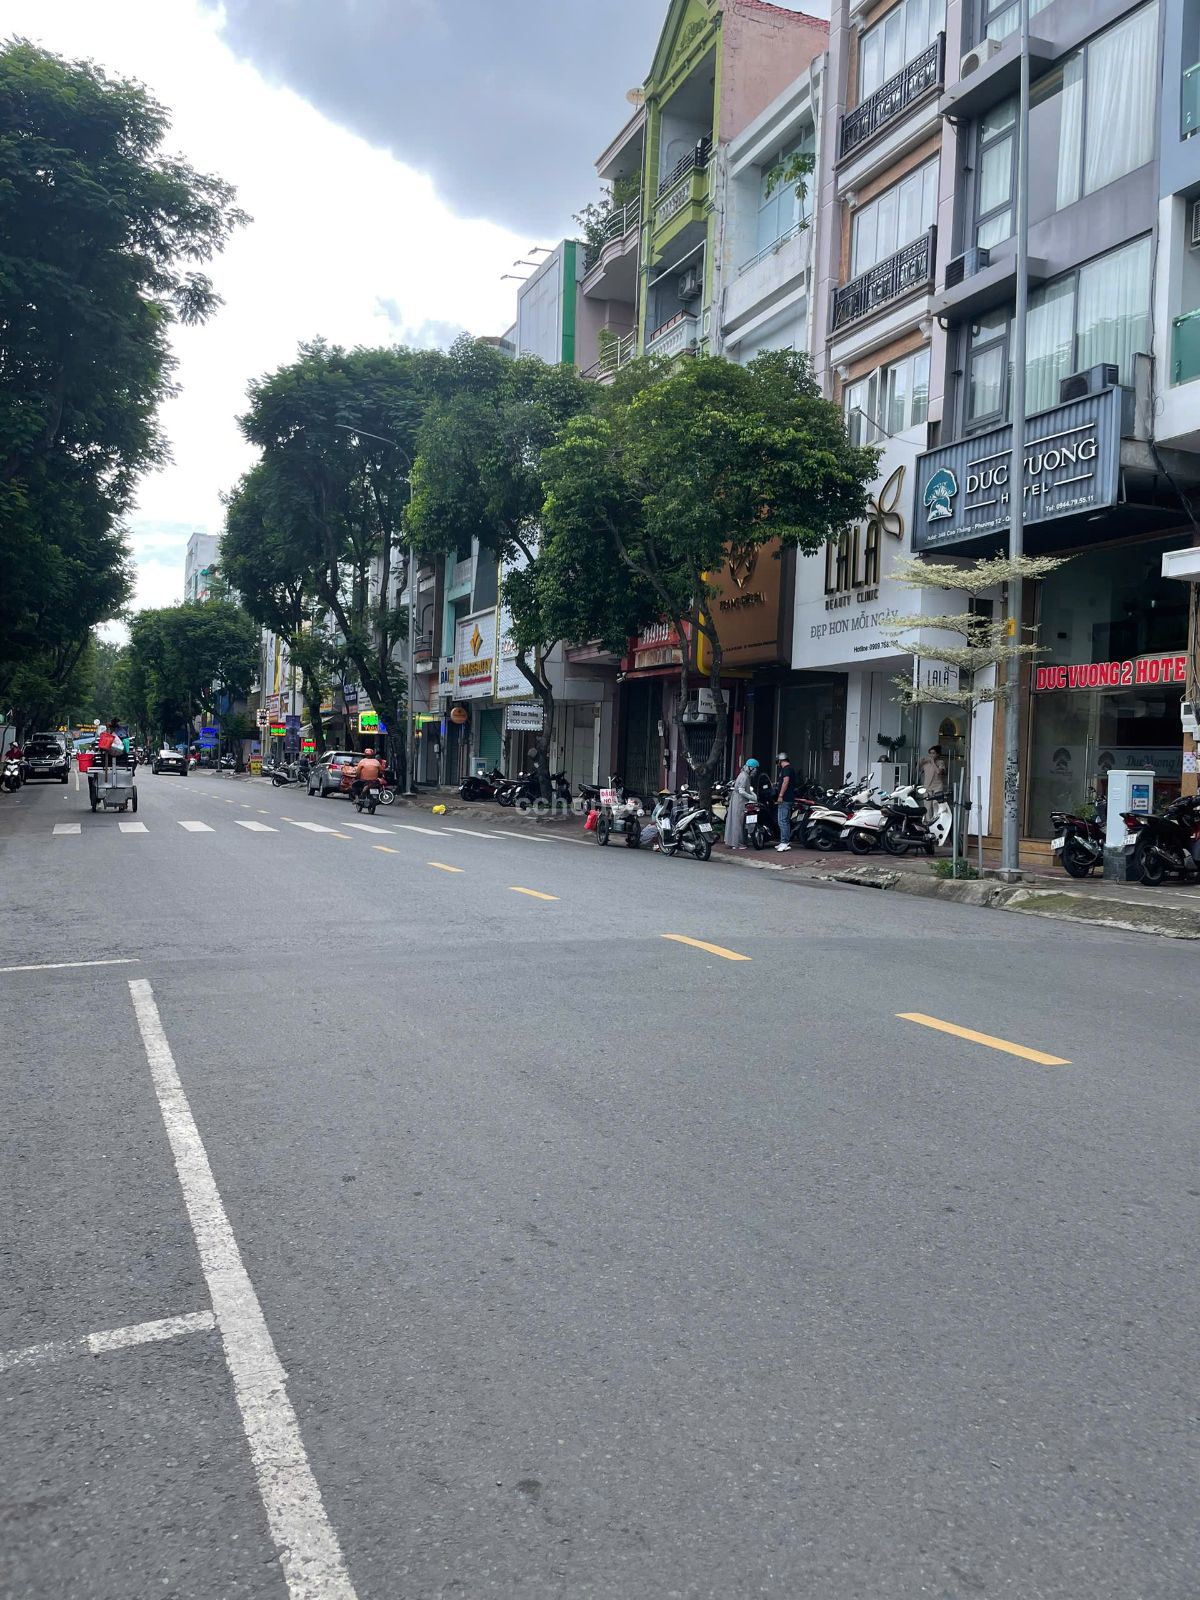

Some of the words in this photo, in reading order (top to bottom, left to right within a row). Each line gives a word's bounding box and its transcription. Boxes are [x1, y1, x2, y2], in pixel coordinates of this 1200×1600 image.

[967, 464, 1009, 494] DUC
[1024, 437, 1098, 475] UONG
[1001, 481, 1049, 504] HTEL
[824, 519, 880, 596] LALA
[825, 594, 852, 612] BEAUTY
[857, 588, 880, 604] CLINIC
[810, 622, 828, 640] ĐẸP
[851, 610, 870, 632] MỖI
[927, 669, 950, 687] LALA
[1135, 655, 1187, 684] HOTE
